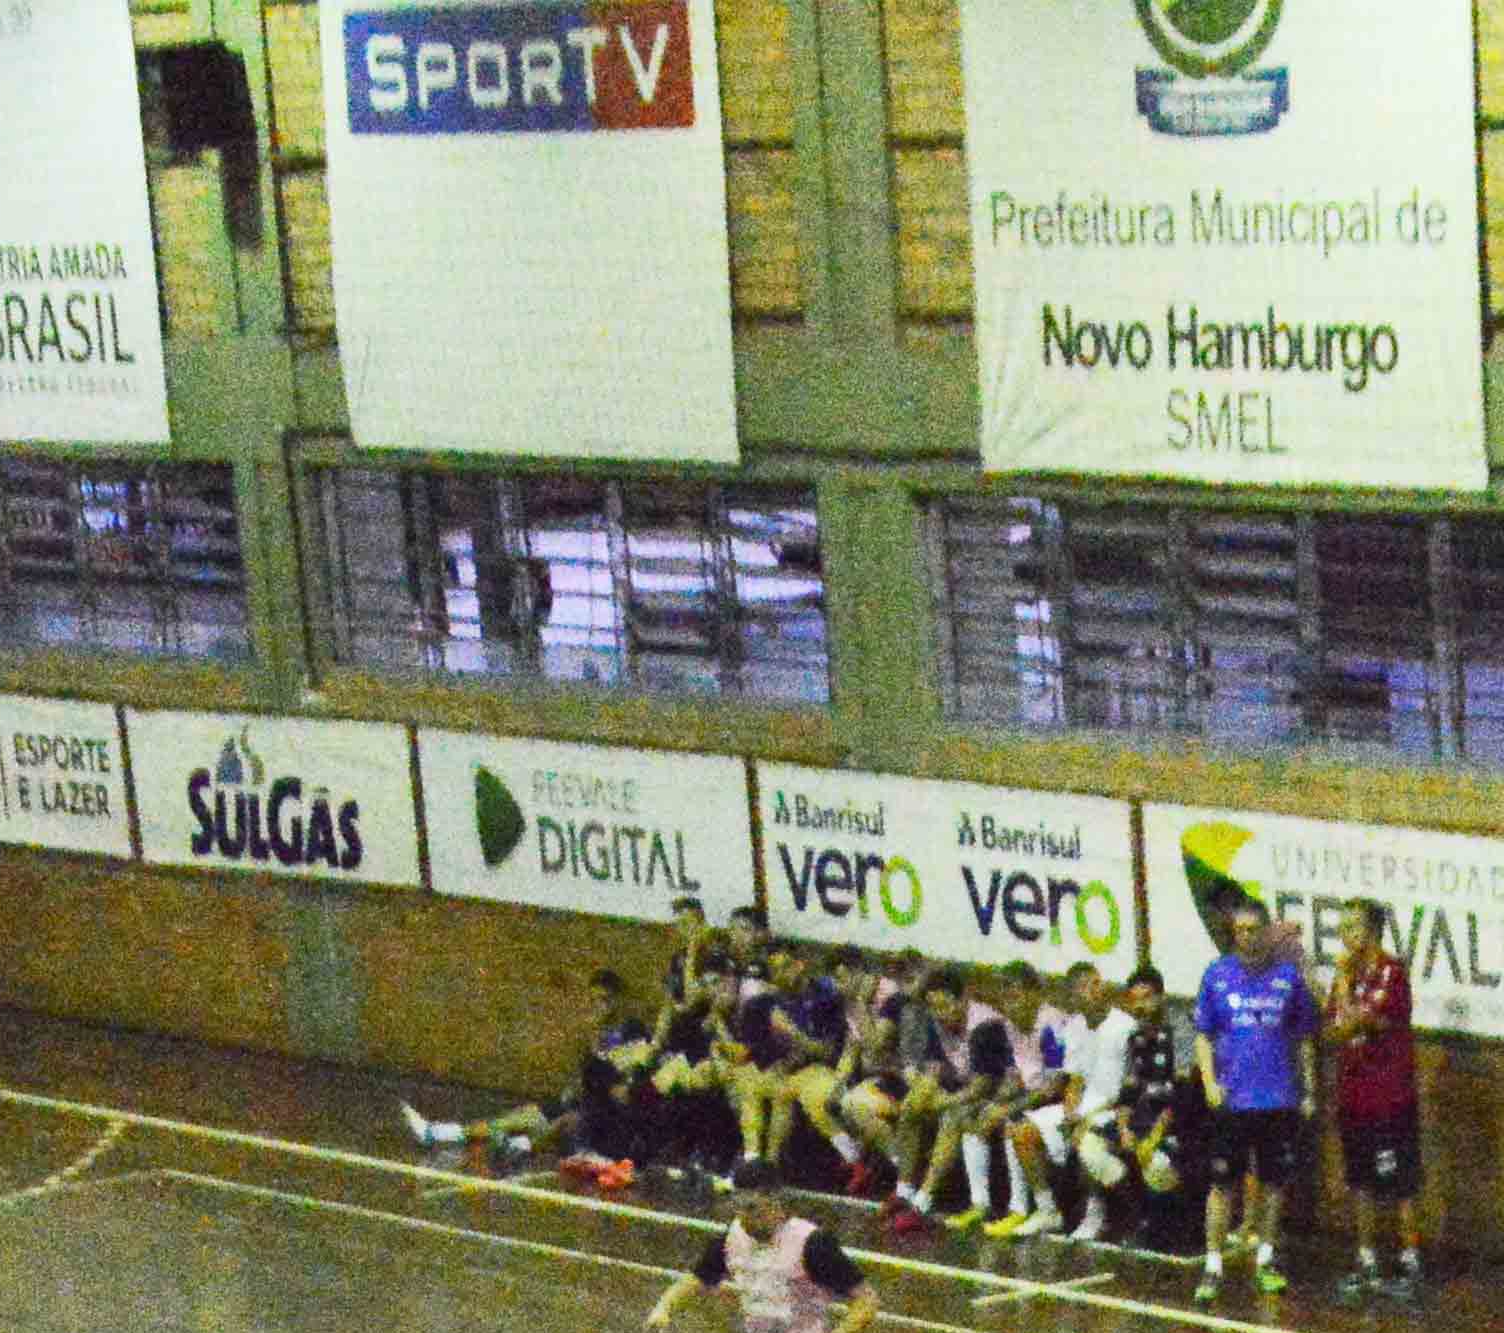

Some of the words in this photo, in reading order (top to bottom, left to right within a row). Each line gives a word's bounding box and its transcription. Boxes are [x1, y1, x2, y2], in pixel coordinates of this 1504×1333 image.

[989, 190, 1175, 248] Prefeitura
[1190, 187, 1381, 259] Municipal
[1397, 187, 1448, 247] de
[49, 242, 128, 280] AMADA
[1041, 303, 1154, 371] Novo
[1167, 303, 1400, 393] Hamburgo
[1166, 387, 1289, 454] SMEL
[14, 730, 113, 774] ESPORTE
[42, 782, 113, 819] LAZER
[795, 792, 886, 838] Banrisul
[536, 814, 702, 894] DIGITAL
[980, 813, 1084, 862] Banrisul
[775, 838, 924, 928] vero
[960, 861, 1122, 956] vero
